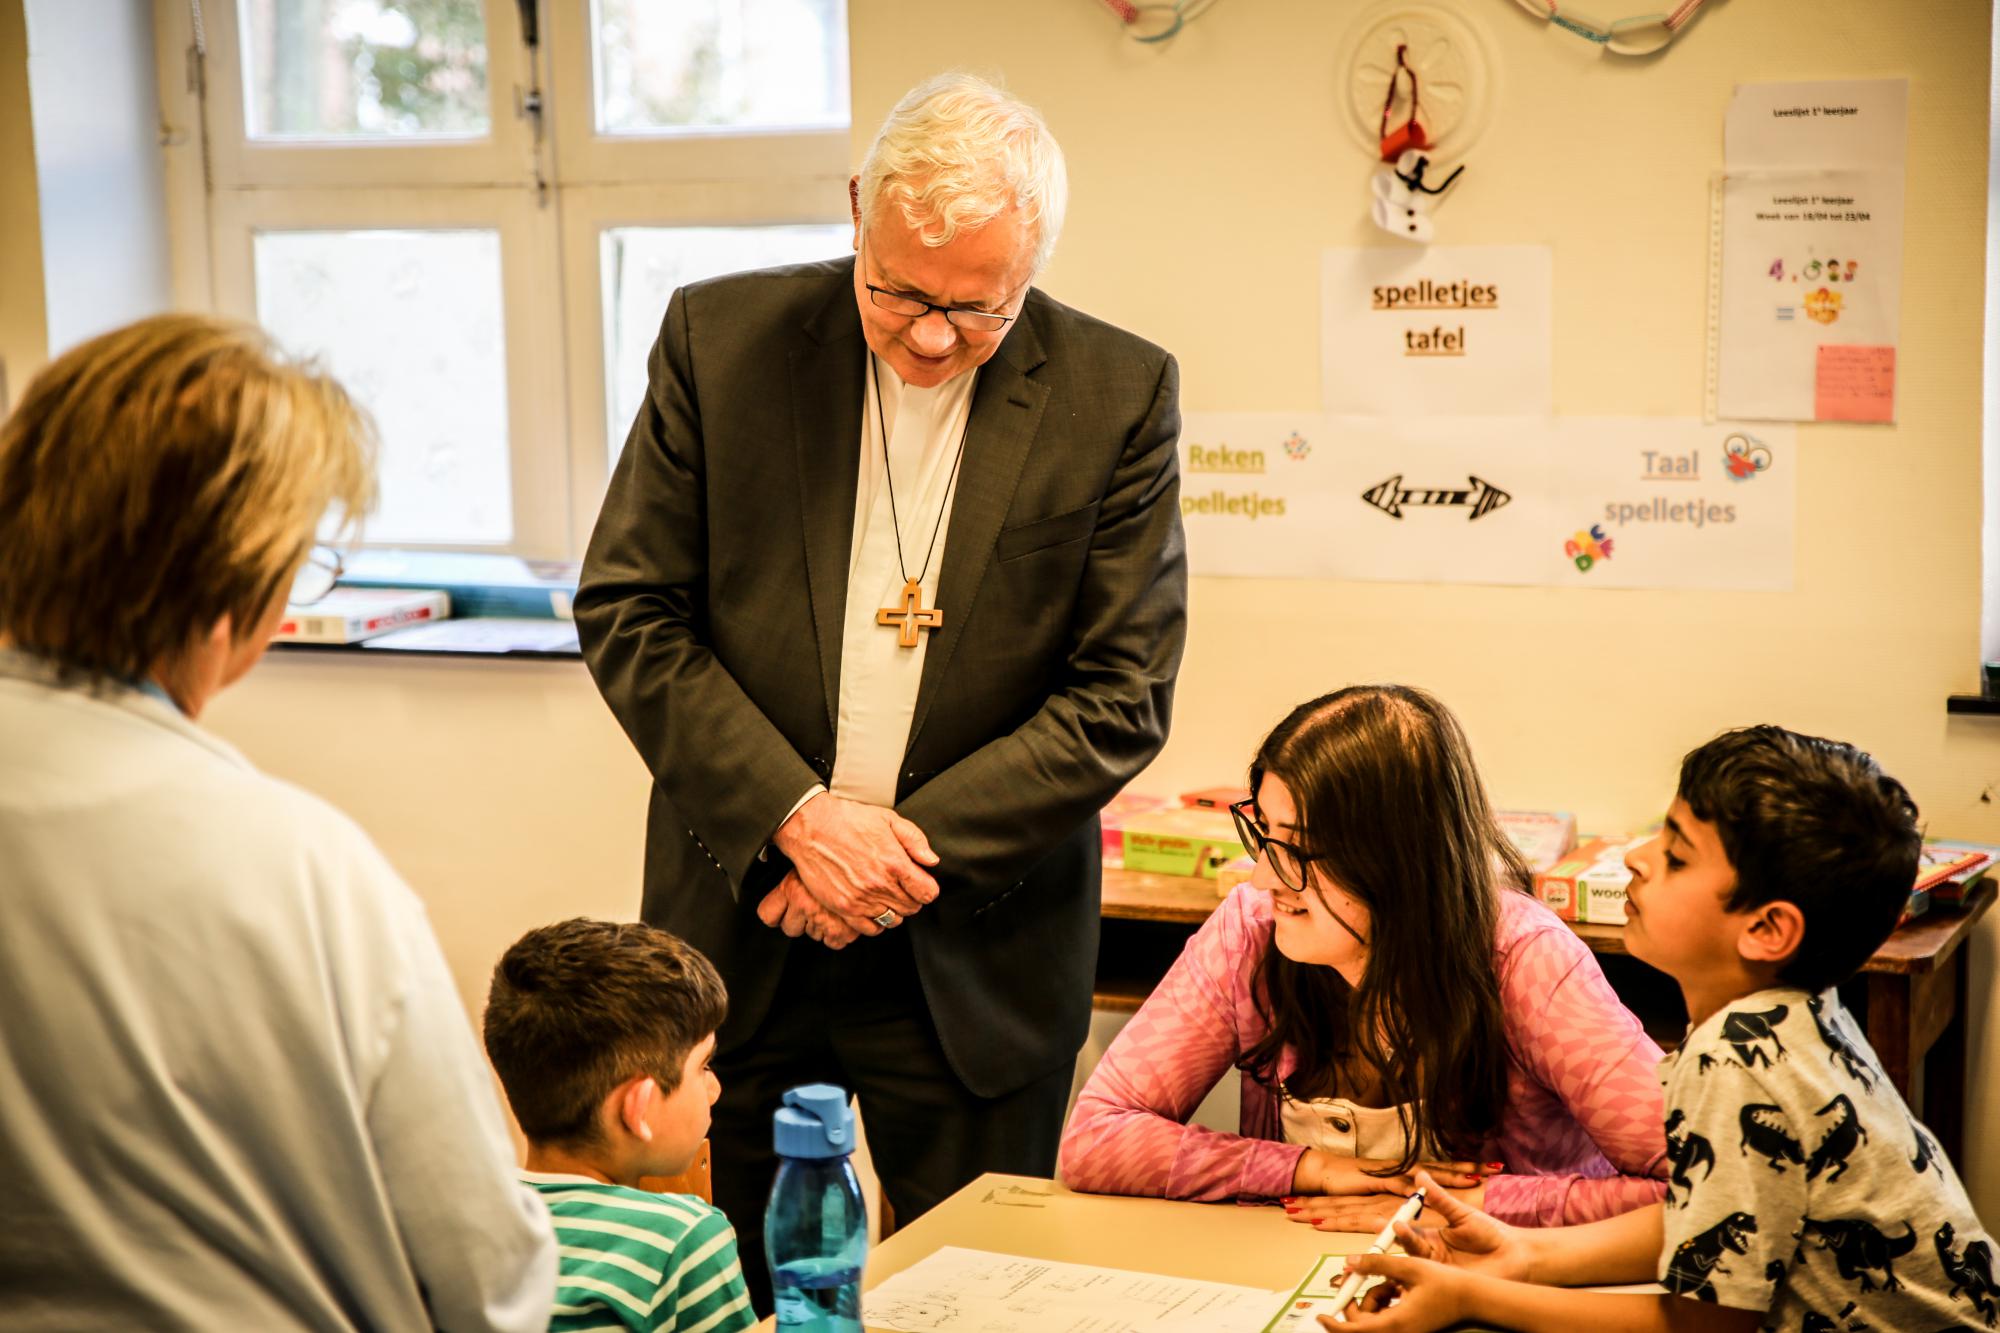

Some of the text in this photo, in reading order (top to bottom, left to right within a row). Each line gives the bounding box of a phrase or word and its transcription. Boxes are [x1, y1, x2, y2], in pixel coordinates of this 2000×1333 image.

[1773, 107, 1810, 118] Leeslijst
[1823, 106, 1858, 118] leerjaar
[1821, 195, 1855, 206] leerjaar
[1372, 279, 1498, 309] spelletjes
[1405, 327, 1465, 353] tafel
[1189, 445, 1265, 469] Reken
[1642, 450, 1699, 476] Taal
[1181, 492, 1285, 519] pelletjes
[1606, 498, 1736, 526] spelletjes
